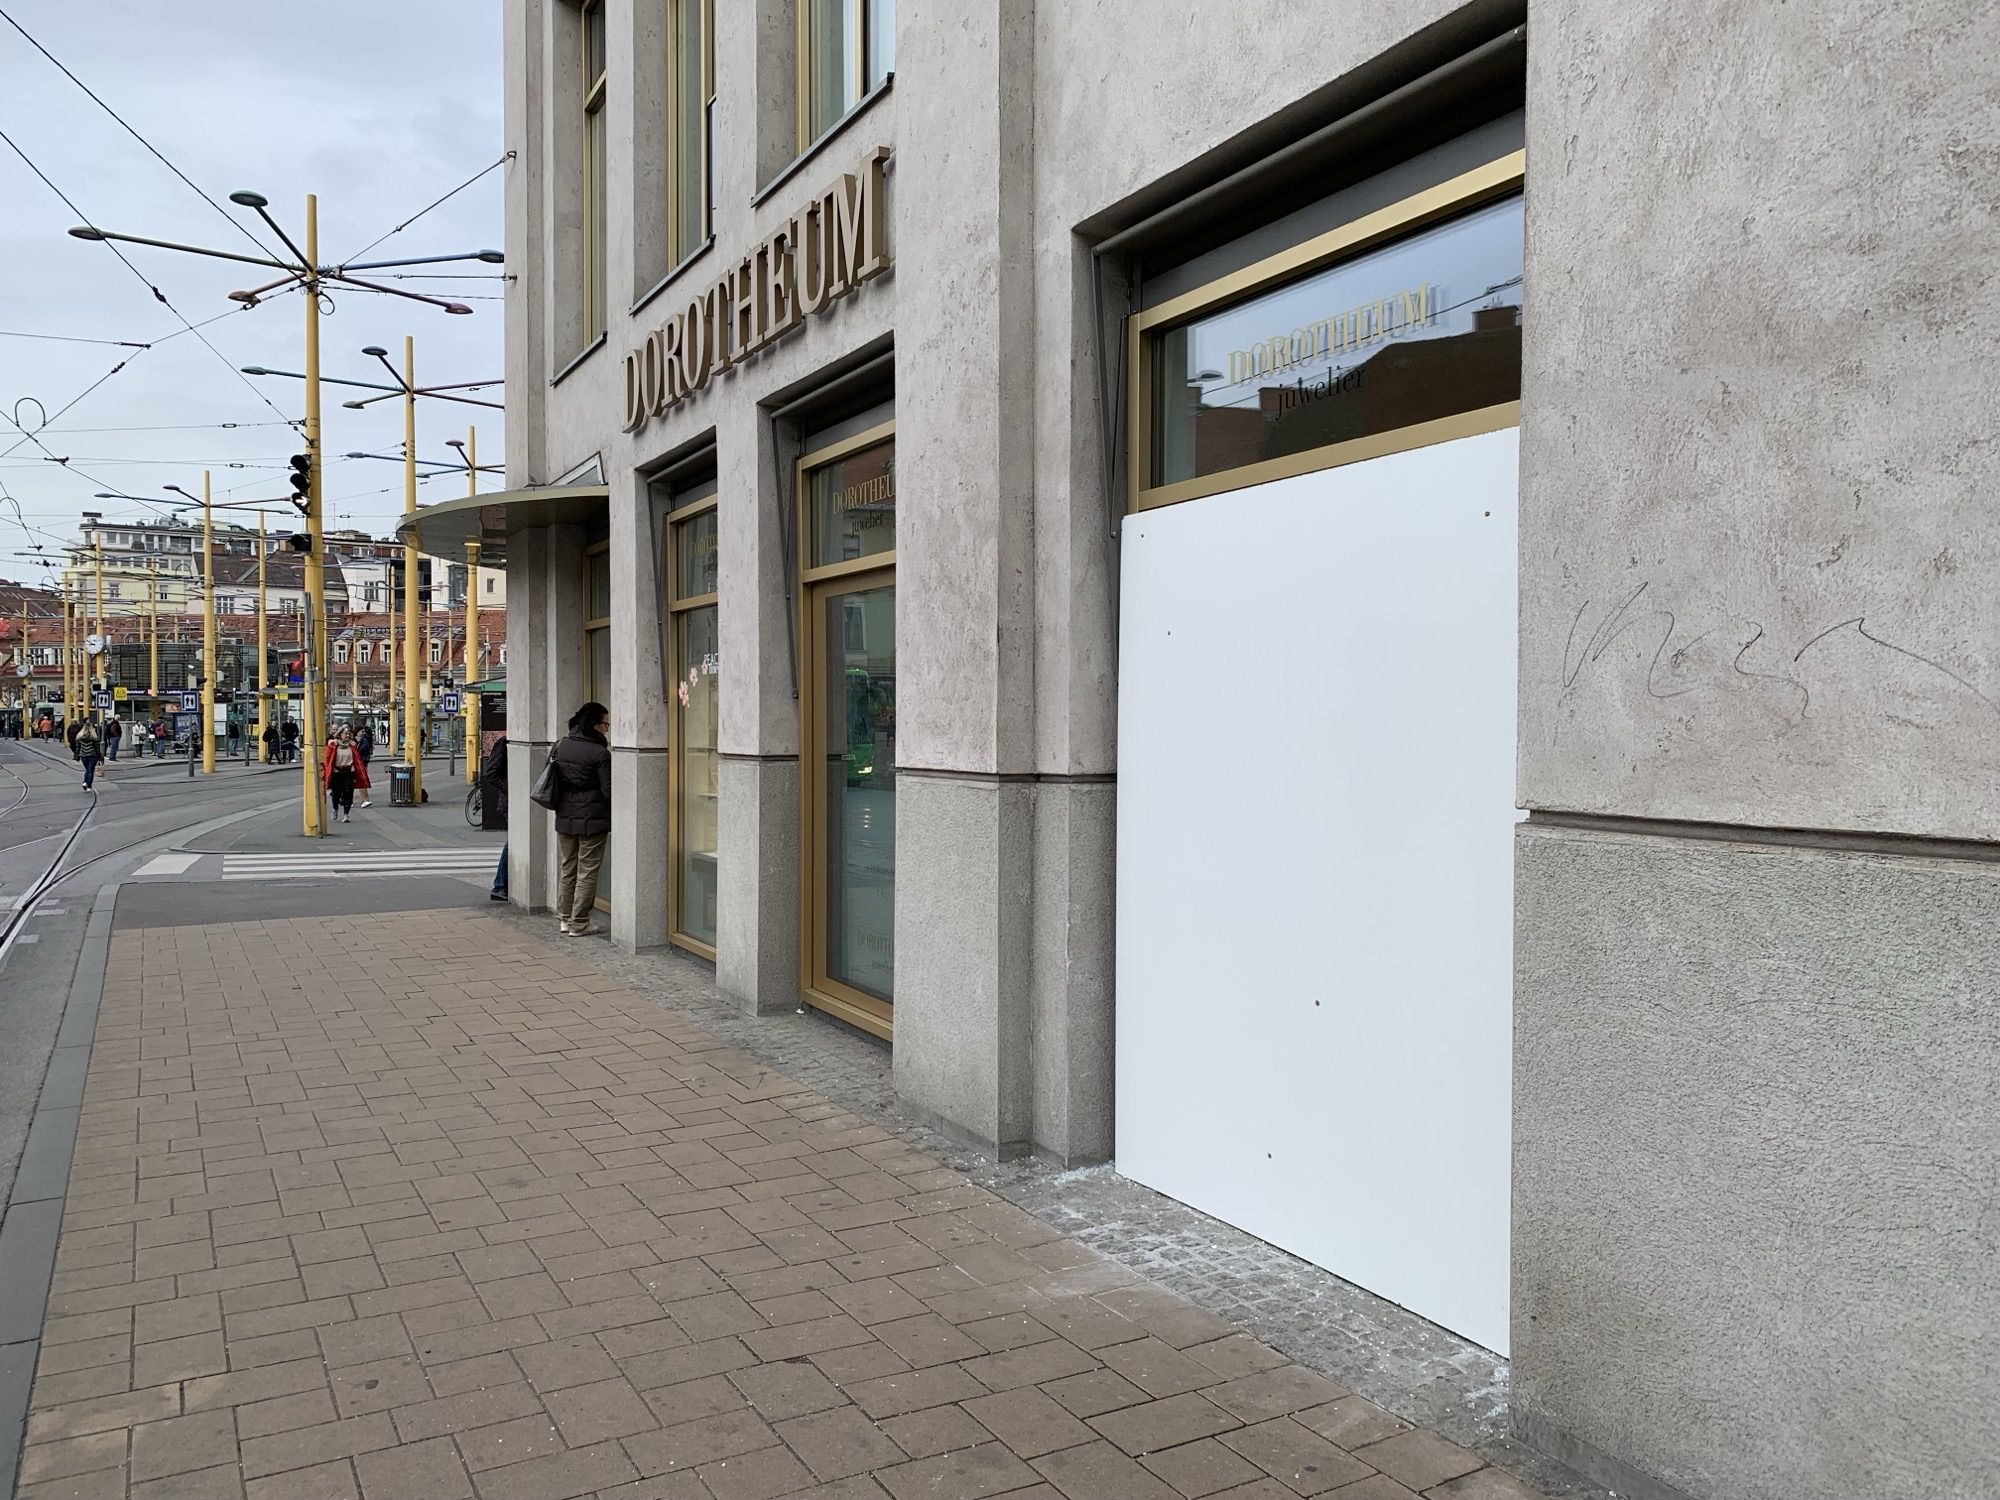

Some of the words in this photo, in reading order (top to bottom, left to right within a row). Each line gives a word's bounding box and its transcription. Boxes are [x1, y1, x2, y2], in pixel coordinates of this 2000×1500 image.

[621, 145, 891, 434] DOROTHEUM
[1227, 281, 1430, 386] DOROTHEUM
[1275, 364, 1366, 422] juwelier
[851, 510, 884, 539] juwelier
